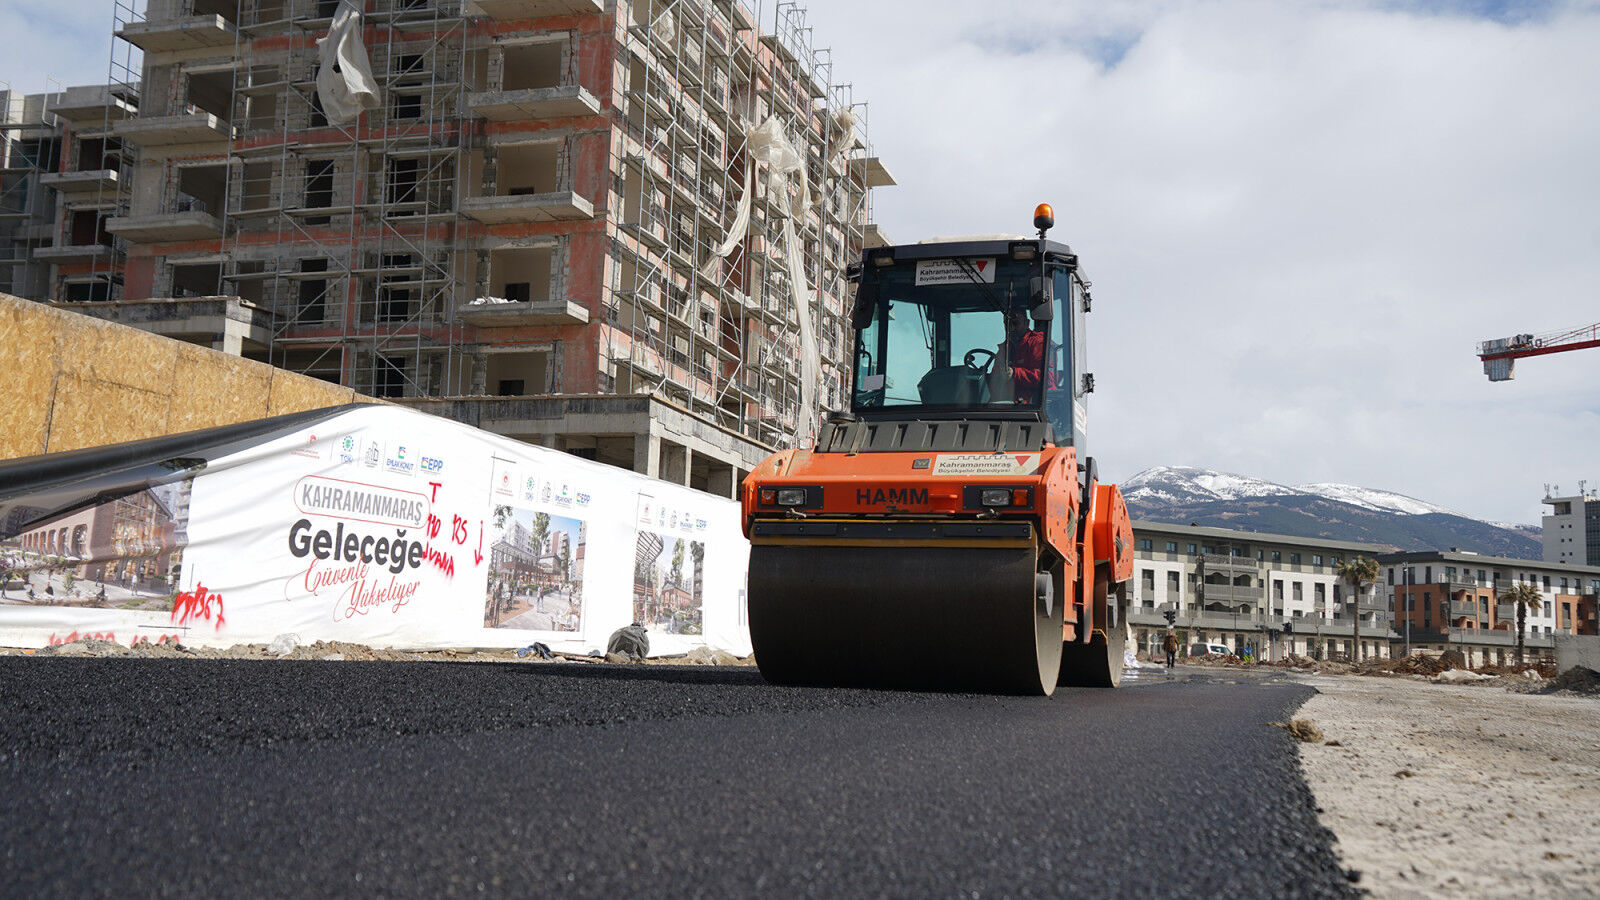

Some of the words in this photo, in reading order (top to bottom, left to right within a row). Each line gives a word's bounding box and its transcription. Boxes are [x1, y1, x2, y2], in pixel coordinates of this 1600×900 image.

[920, 269, 974, 277] Kahramanmaaş
[428, 458, 444, 471] EPP
[302, 483, 423, 526] KAHRAMANMARAŞ
[429, 481, 442, 503] T
[856, 488, 928, 505] HAMM
[288, 518, 423, 574] Geleceğe
[285, 553, 370, 601] Güvenle
[333, 576, 420, 622] Yükseliyor
